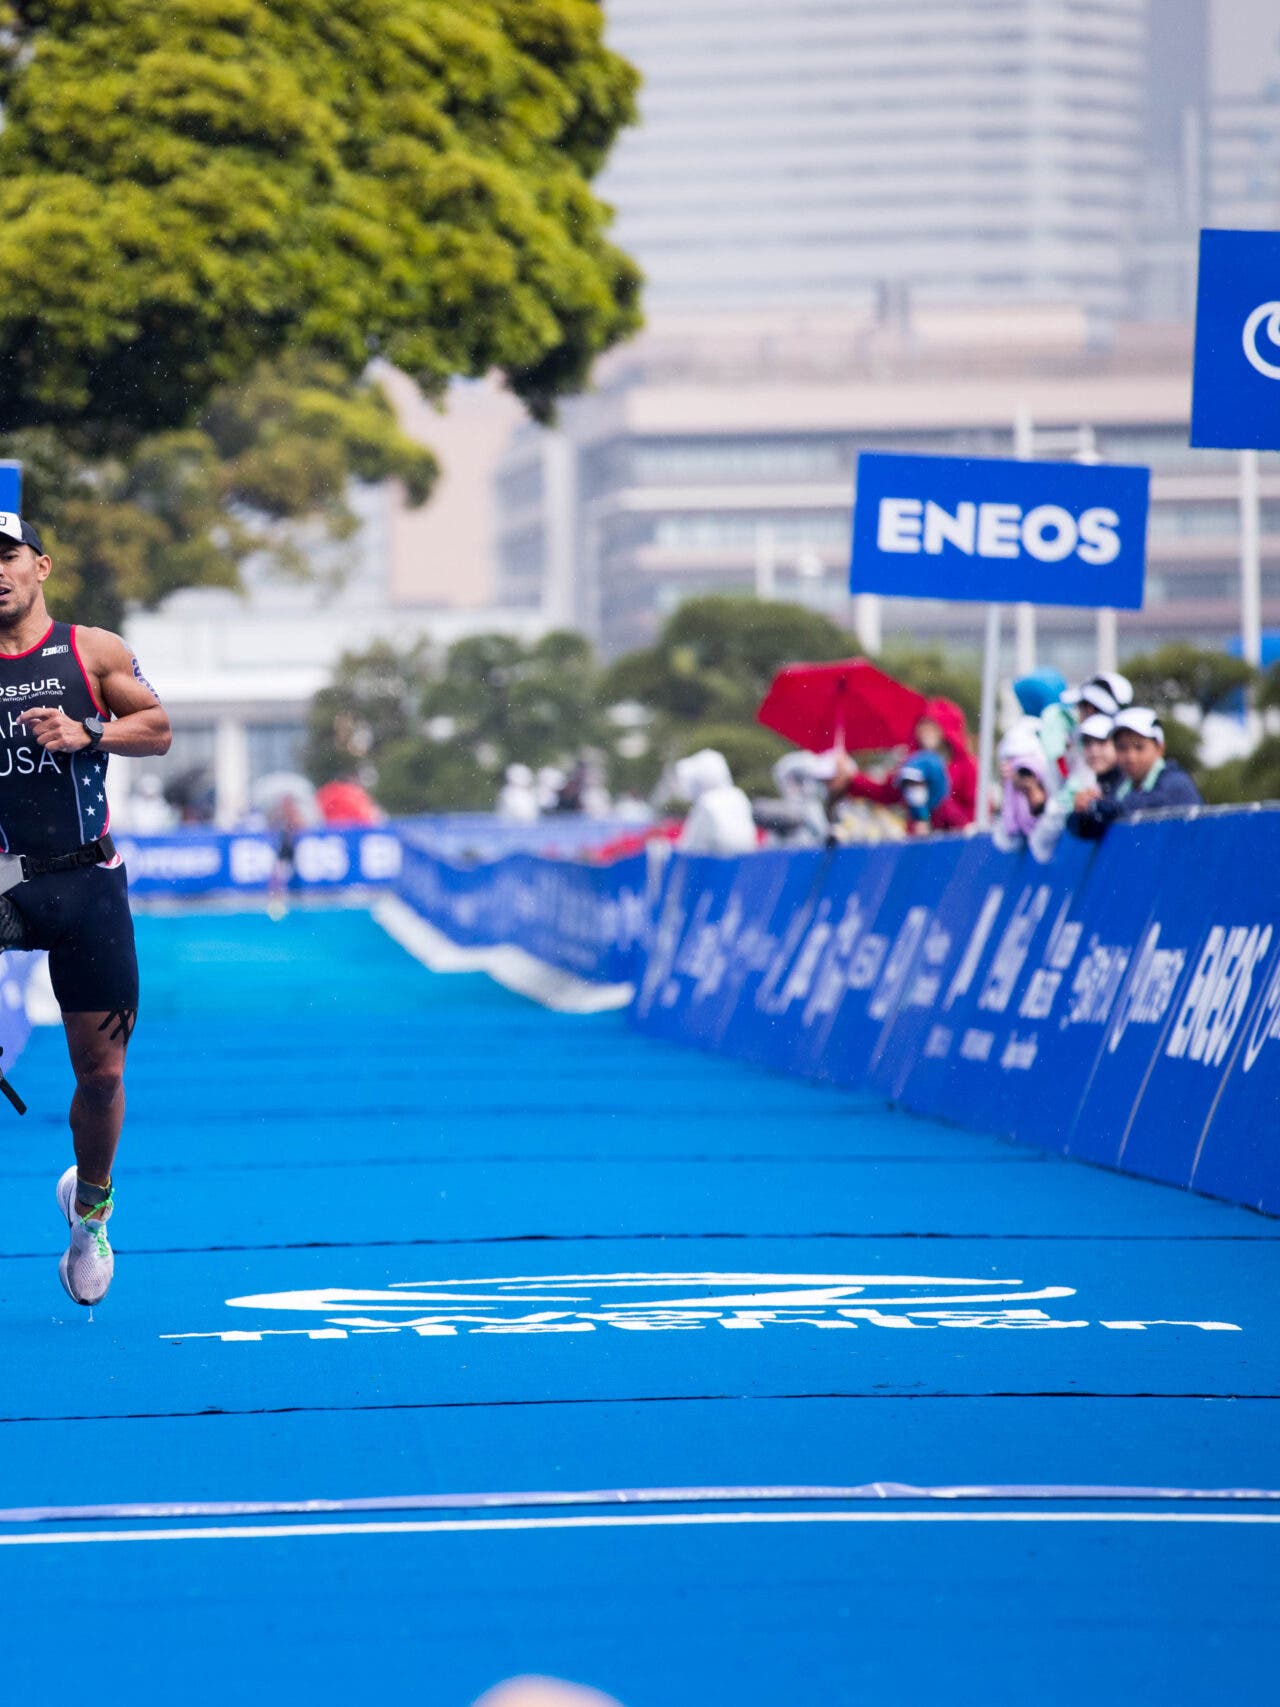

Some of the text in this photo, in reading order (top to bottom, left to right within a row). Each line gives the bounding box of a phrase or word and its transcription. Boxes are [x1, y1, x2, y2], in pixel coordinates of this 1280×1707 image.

[877, 497, 1121, 566] ENEOS
[2, 695, 27, 703] WITHOUT
[1165, 923, 1273, 1068] ENEOS
